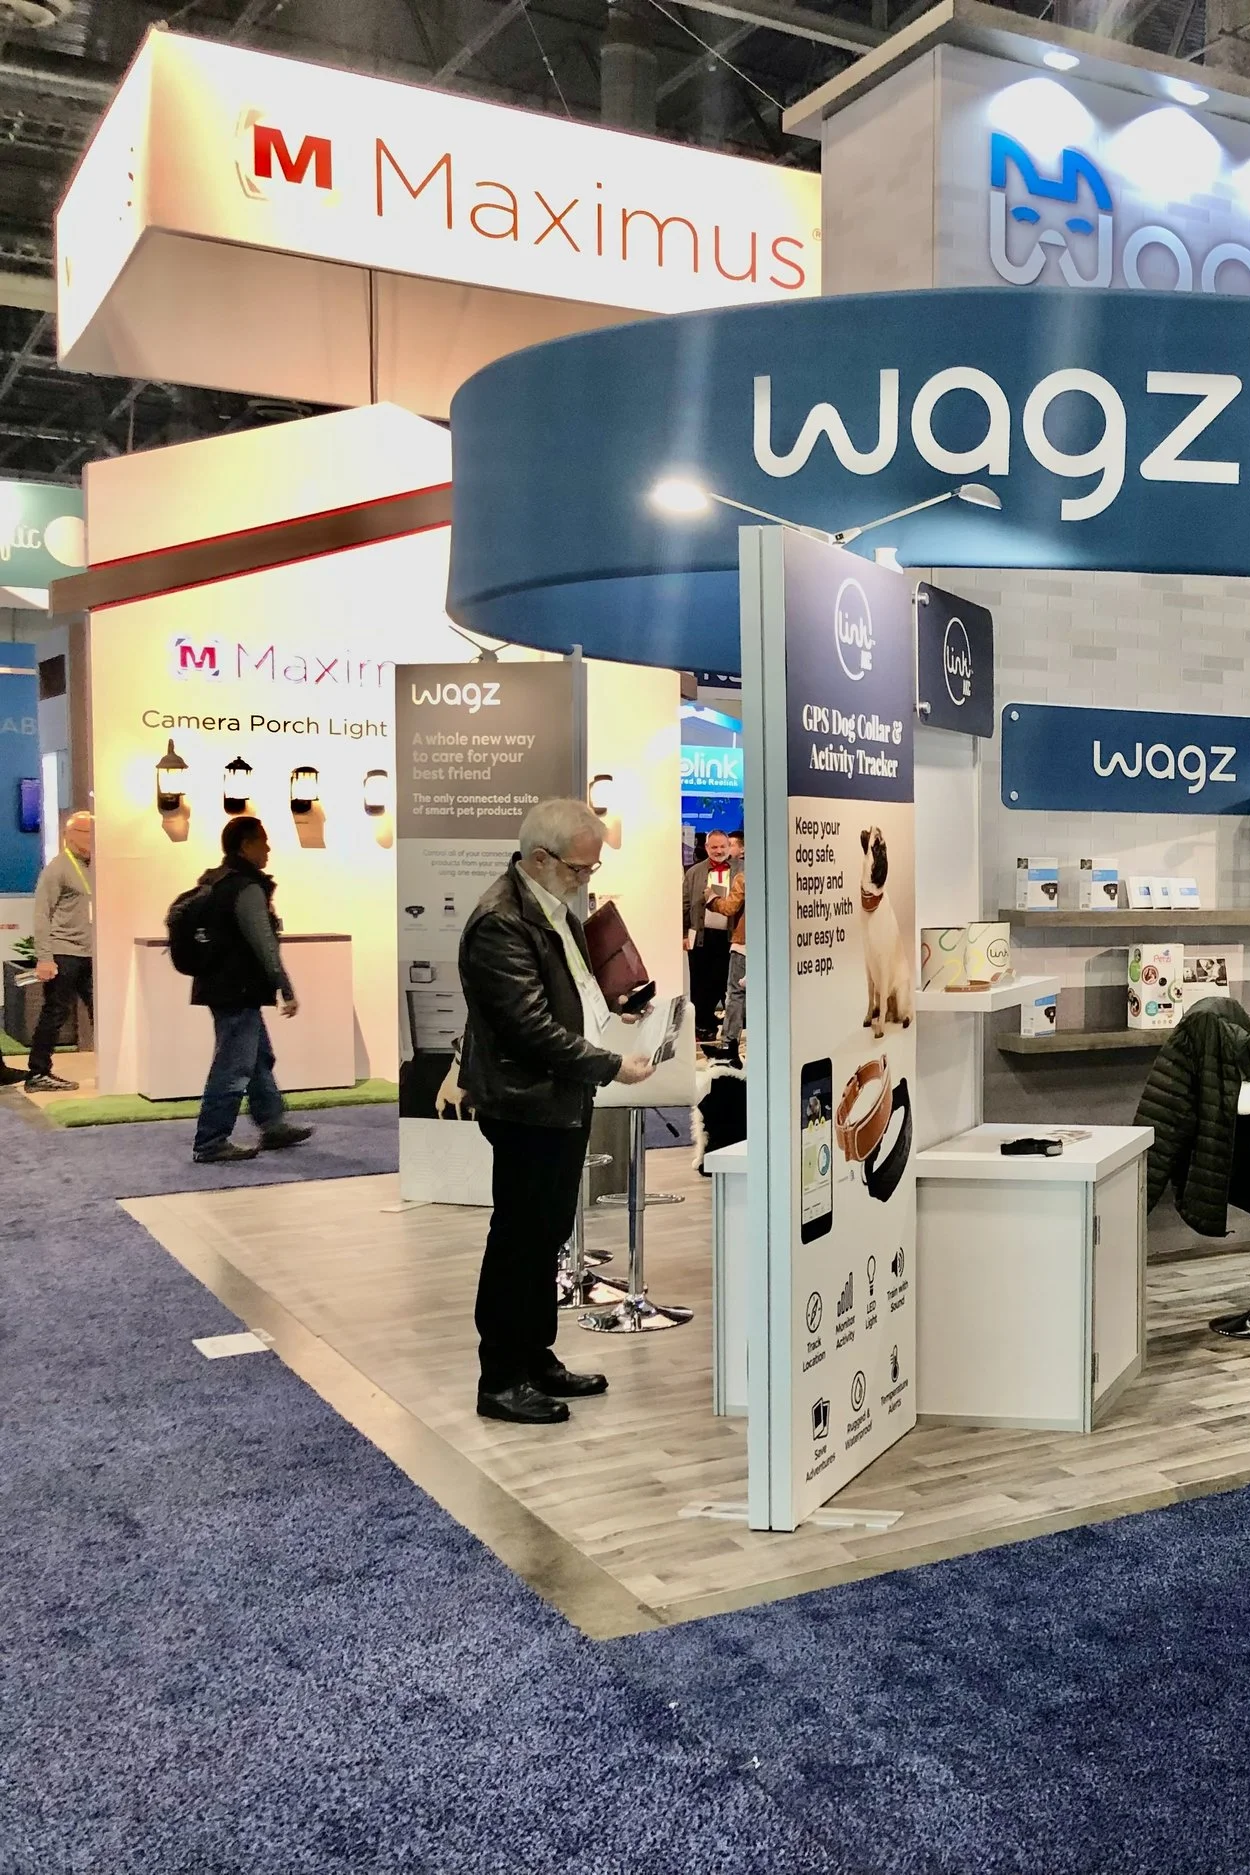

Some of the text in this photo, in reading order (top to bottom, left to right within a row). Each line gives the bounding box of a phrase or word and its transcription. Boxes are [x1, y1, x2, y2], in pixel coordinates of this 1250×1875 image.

[374, 136, 807, 291] Maximus
[753, 365, 1244, 522] wagz
[411, 682, 501, 714] wagz
[141, 709, 389, 740] Camera Porch Light
[802, 703, 903, 745] GPS Dog Collar &
[412, 732, 536, 749] A whole new way
[412, 749, 524, 767] to care for your
[809, 743, 899, 779] Activity Tracker
[1093, 739, 1237, 794] wagz
[412, 766, 492, 780] best friend
[412, 792, 540, 806] The only connected suite
[412, 805, 523, 818] of smart pet products
[795, 816, 841, 841] Keep your
[795, 843, 836, 867] dog safe,
[796, 871, 844, 895] happy and
[796, 897, 854, 921] healthy, with
[796, 926, 845, 948] our easy to
[797, 956, 834, 977] use app.
[866, 1299, 877, 1314] LED
[890, 1294, 905, 1313] Sound
[835, 1315, 856, 1335] Monitor
[865, 1314, 878, 1330] Light
[806, 1336, 822, 1354] Track
[835, 1329, 856, 1350] Activity
[802, 1351, 826, 1373] Location
[814, 1444, 827, 1461] Save
[805, 1452, 836, 1484] Adventures
